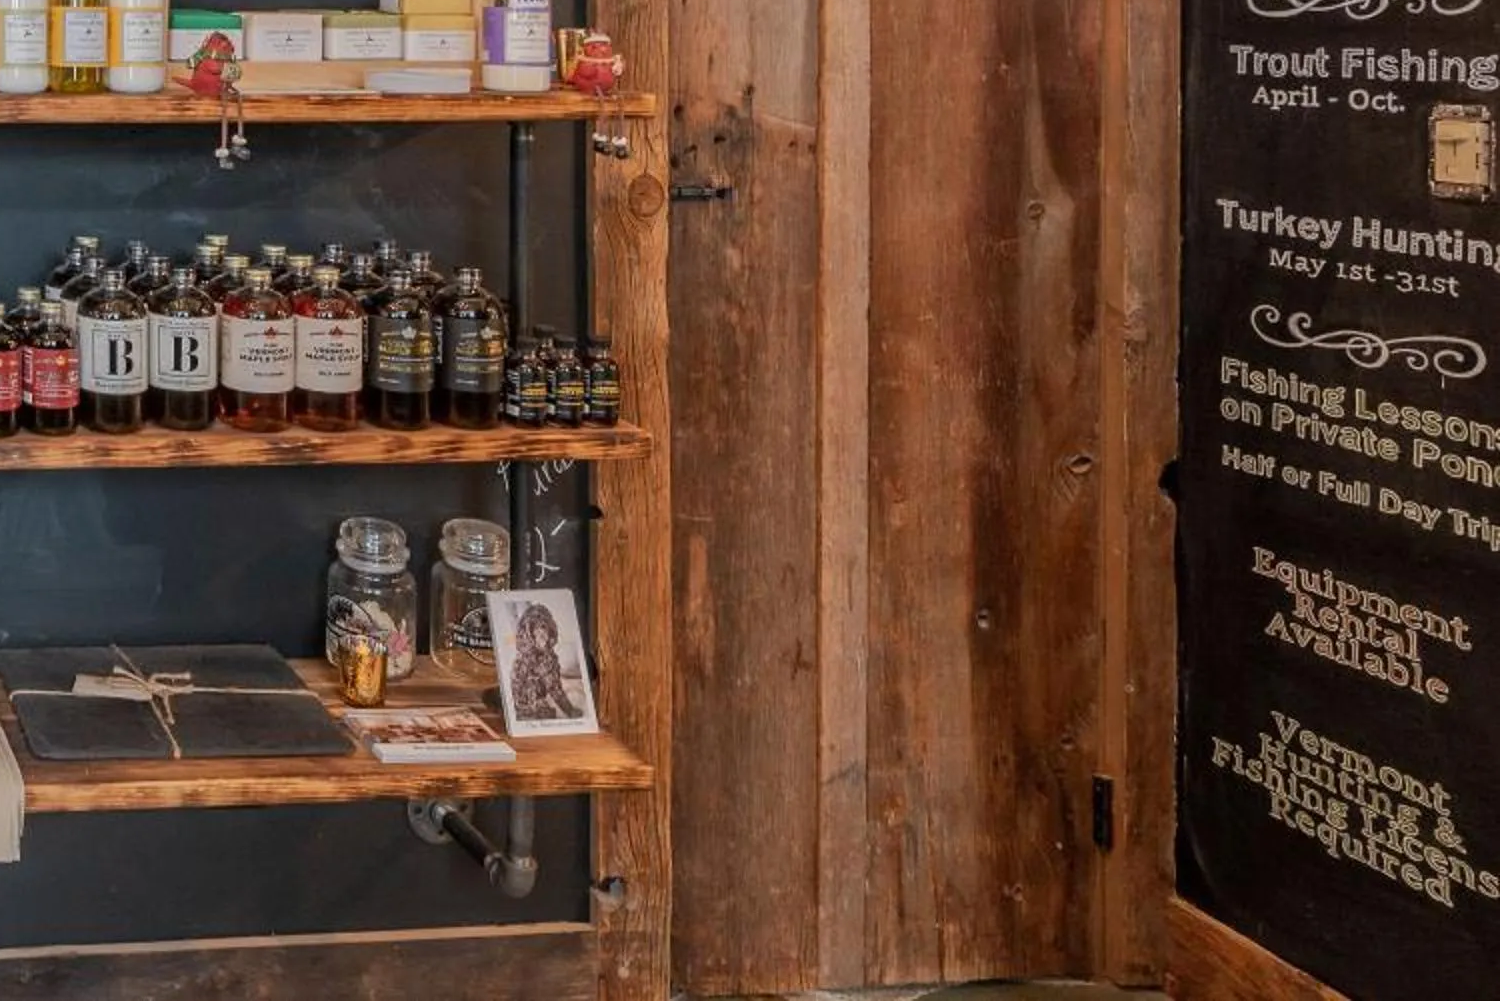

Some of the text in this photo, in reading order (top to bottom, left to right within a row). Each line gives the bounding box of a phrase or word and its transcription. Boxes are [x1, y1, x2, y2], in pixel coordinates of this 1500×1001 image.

[1229, 45, 1500, 91] Trout Fishing
[1252, 86, 1320, 110] April
[1348, 89, 1406, 113] Oct.
[1216, 198, 1342, 249] Turkey
[1269, 248, 1327, 278] May
[1336, 261, 1377, 283] 1st
[107, 339, 134, 376] B
[173, 336, 199, 372] B
[1221, 356, 1347, 418] Fishing
[1220, 398, 1262, 427] on
[1271, 402, 1400, 461] Private
[1221, 445, 1276, 478] Half
[1282, 464, 1312, 489] or
[1318, 471, 1371, 507] Full
[1379, 488, 1442, 531] Day
[1251, 546, 1472, 651] Equipment
[1292, 591, 1420, 663] Rental
[1264, 612, 1450, 704] Available
[1211, 736, 1349, 831] Fishing
[1258, 732, 1467, 855] Hunting &
[1270, 711, 1451, 817] Vermont
[1269, 791, 1454, 909] Required
